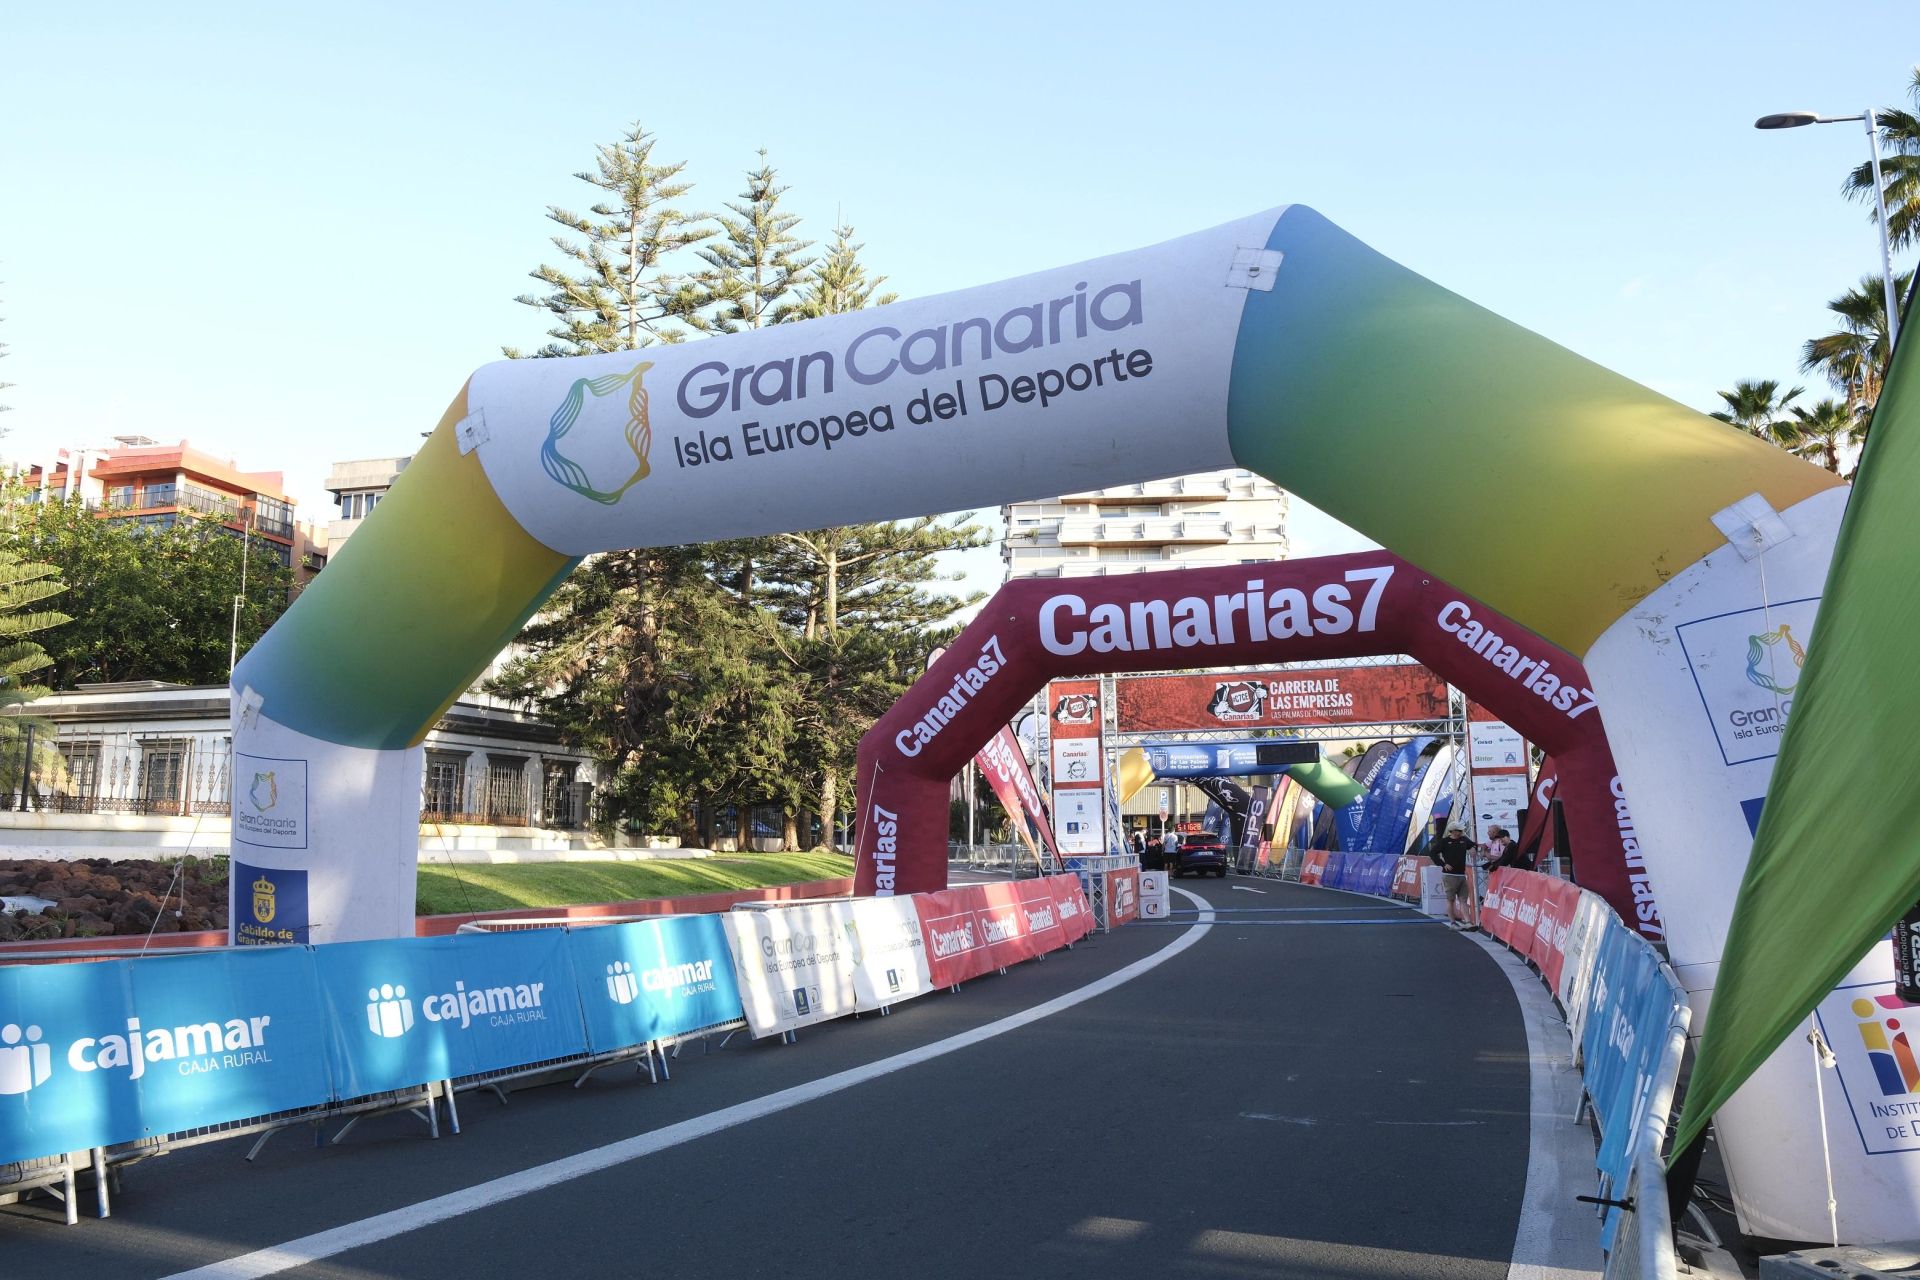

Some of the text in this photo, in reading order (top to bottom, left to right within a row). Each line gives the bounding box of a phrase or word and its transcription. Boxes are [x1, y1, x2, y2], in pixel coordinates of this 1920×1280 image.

[676, 279, 1142, 419] Gran Canaria
[673, 346, 1154, 468] Isla Europea del Deporte
[1039, 566, 1394, 655] Canarias7
[1438, 601, 1600, 719] Canarias7
[895, 634, 1008, 758] Canarias7
[1270, 679, 1339, 695] CARRERA DE
[1270, 693, 1353, 710] LAS EMPRESAS
[1730, 707, 1781, 727] Gran
[1733, 723, 1786, 740] Isla Europ
[1363, 756, 1387, 785] EVENTOS
[257, 815, 296, 828] Canaria
[1244, 800, 1264, 848] HPS
[240, 922, 293, 939] Cabildo de
[931, 921, 974, 957] Canarias7
[642, 958, 713, 998] cajamar
[766, 962, 779, 973] Isla
[423, 981, 544, 1029] cajamar
[490, 1009, 547, 1027] CAJA RURAL
[68, 1015, 271, 1080] cajamar
[179, 1050, 272, 1076] CAJA RURAL
[1870, 1101, 1920, 1118] INSTIT
